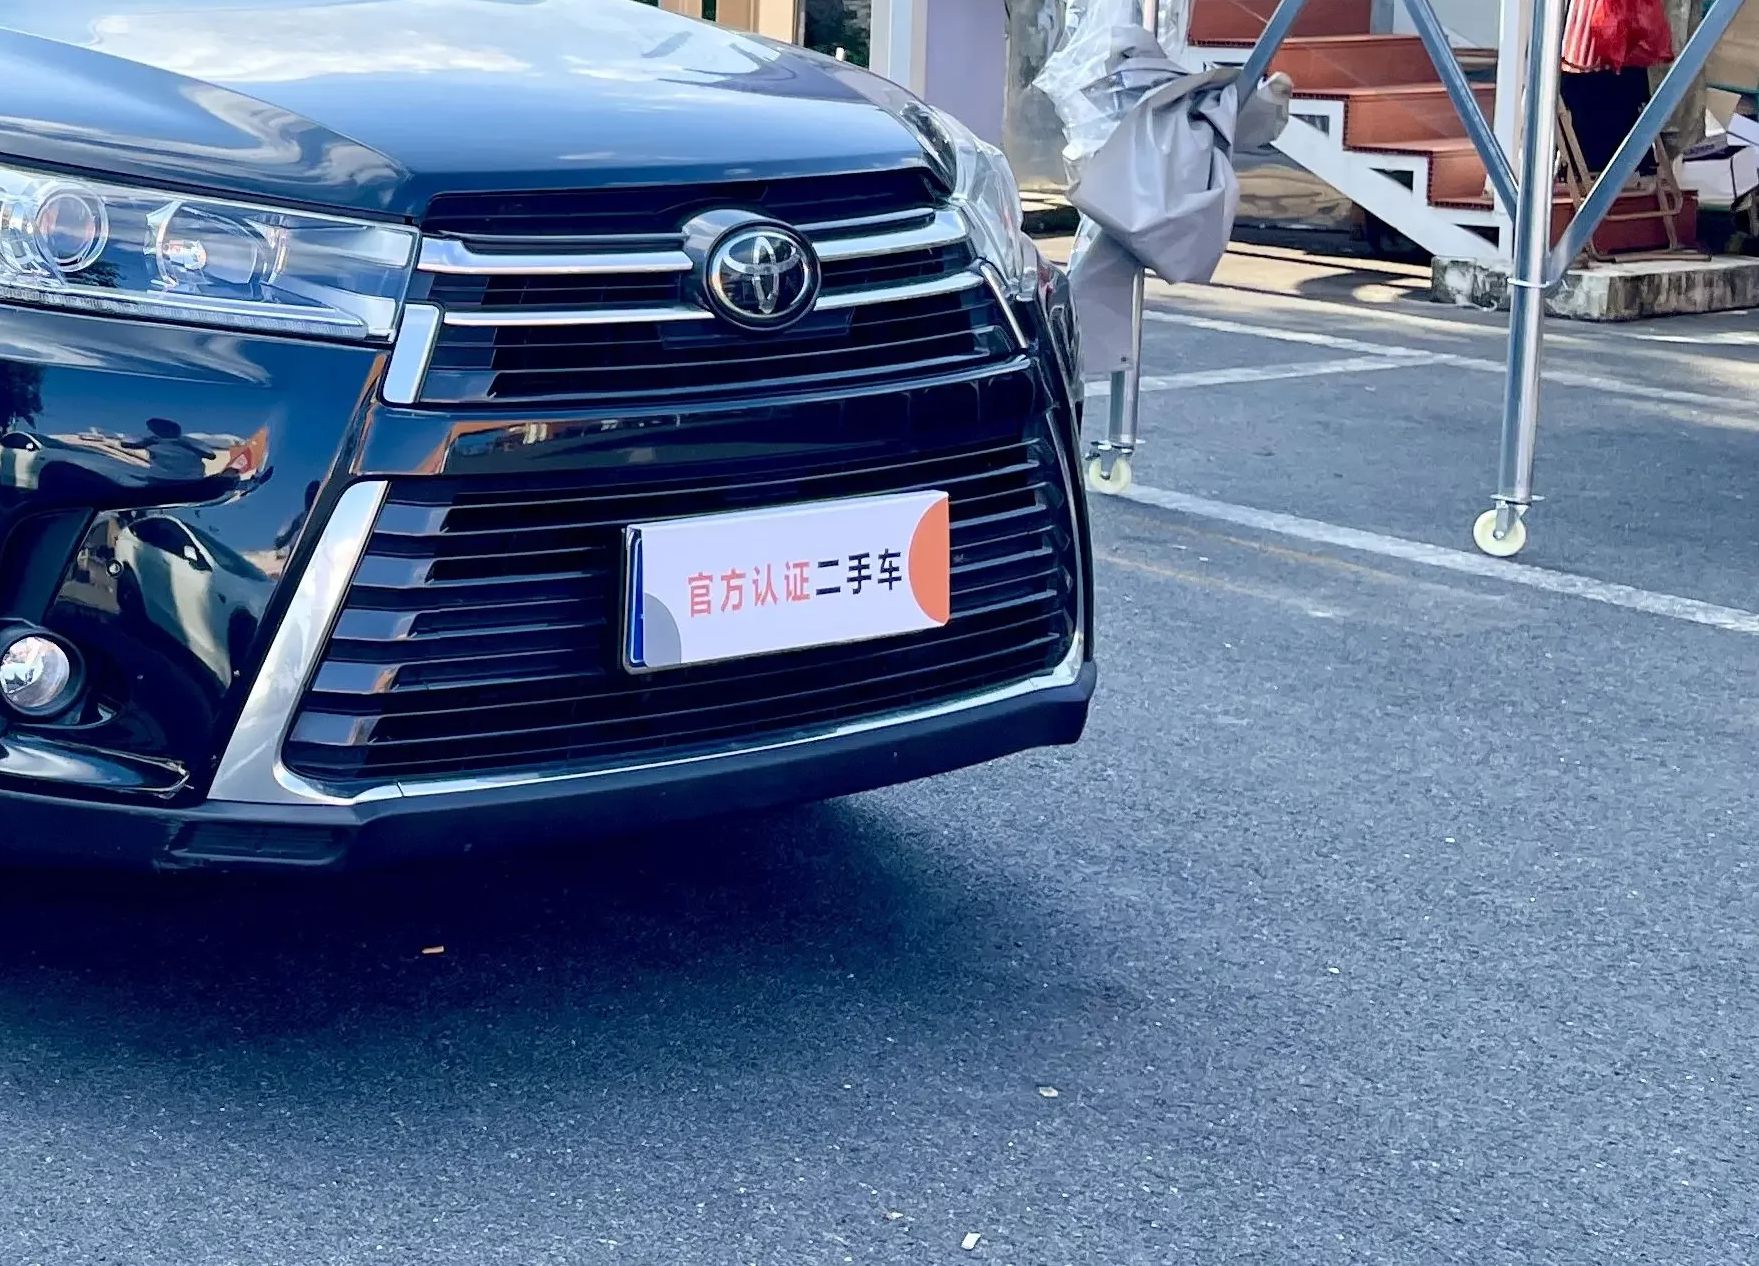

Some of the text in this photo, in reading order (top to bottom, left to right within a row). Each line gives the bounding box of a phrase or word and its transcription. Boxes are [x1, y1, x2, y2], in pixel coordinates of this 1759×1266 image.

[687, 548, 902, 618] 官方认证二手车
